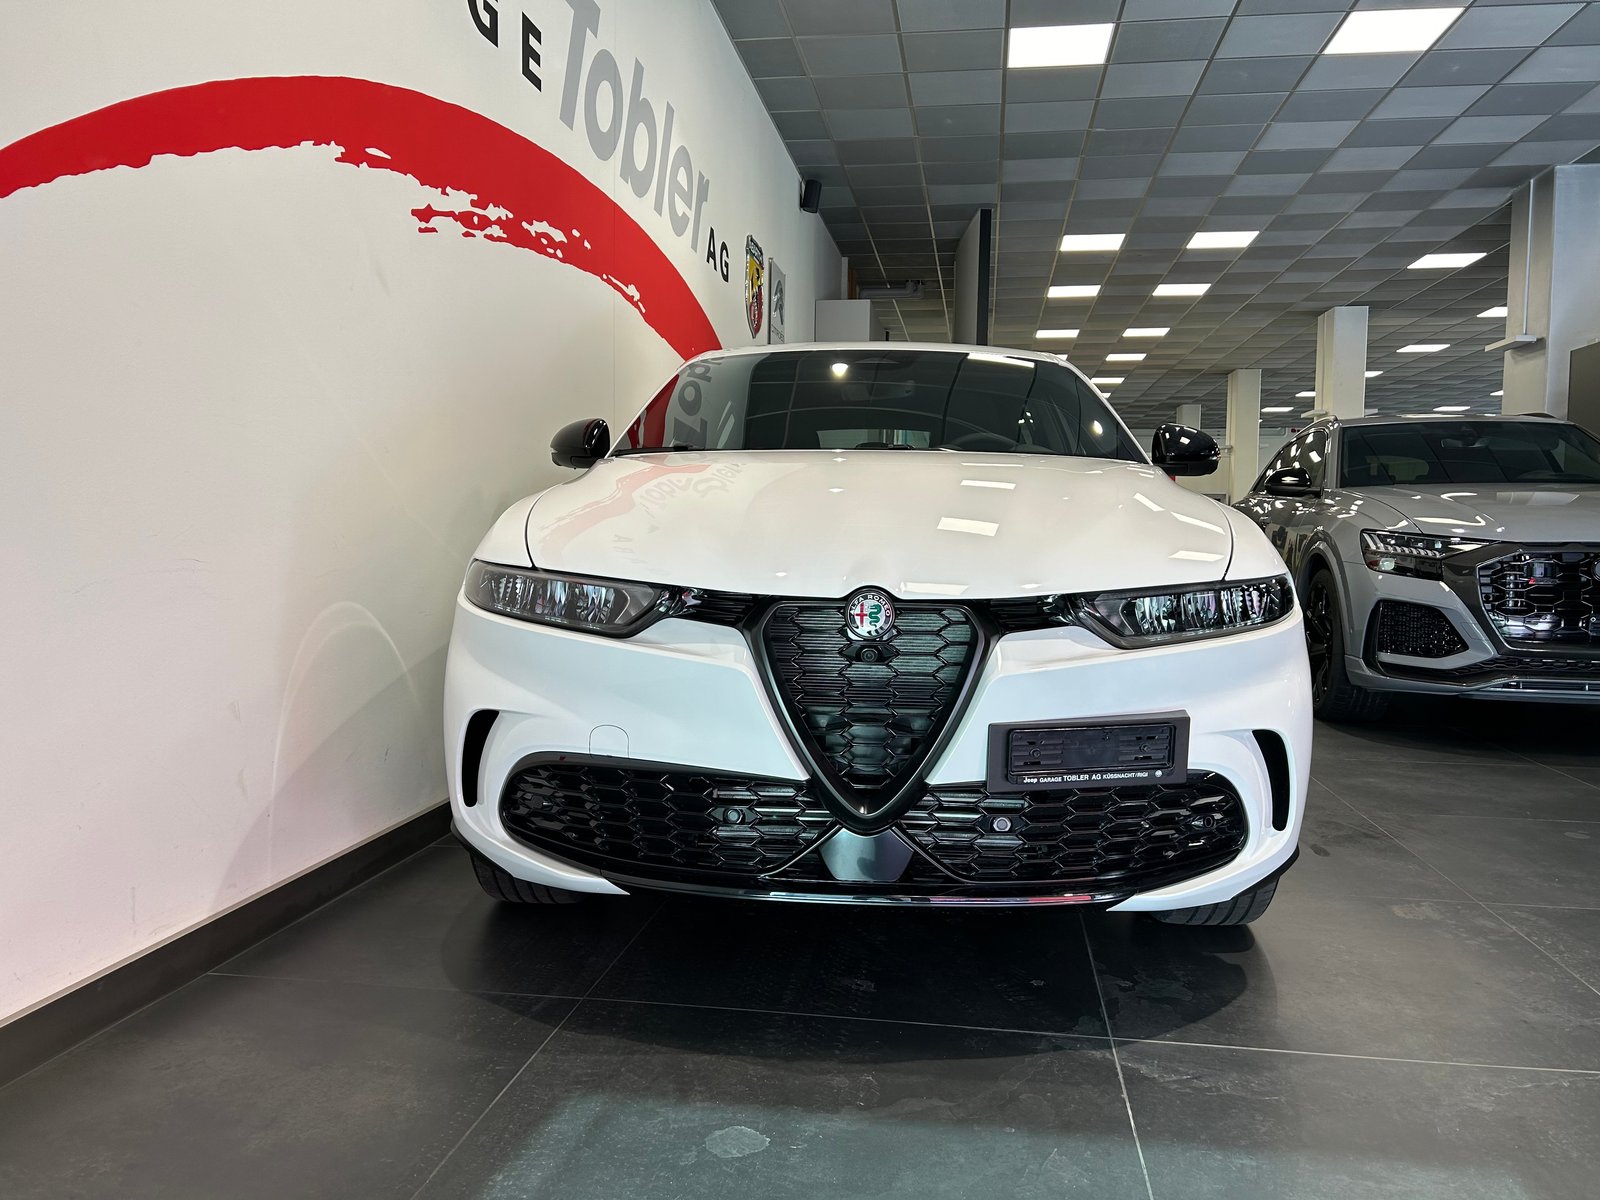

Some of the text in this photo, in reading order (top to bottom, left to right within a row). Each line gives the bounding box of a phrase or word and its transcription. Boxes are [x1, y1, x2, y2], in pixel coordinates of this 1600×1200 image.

[559, 0, 710, 253] Tobler
[706, 226, 729, 283] AG
[867, 594, 891, 617] ROMEO
[1023, 775, 1038, 784] Jeep
[1063, 774, 1089, 782] TOBLER
